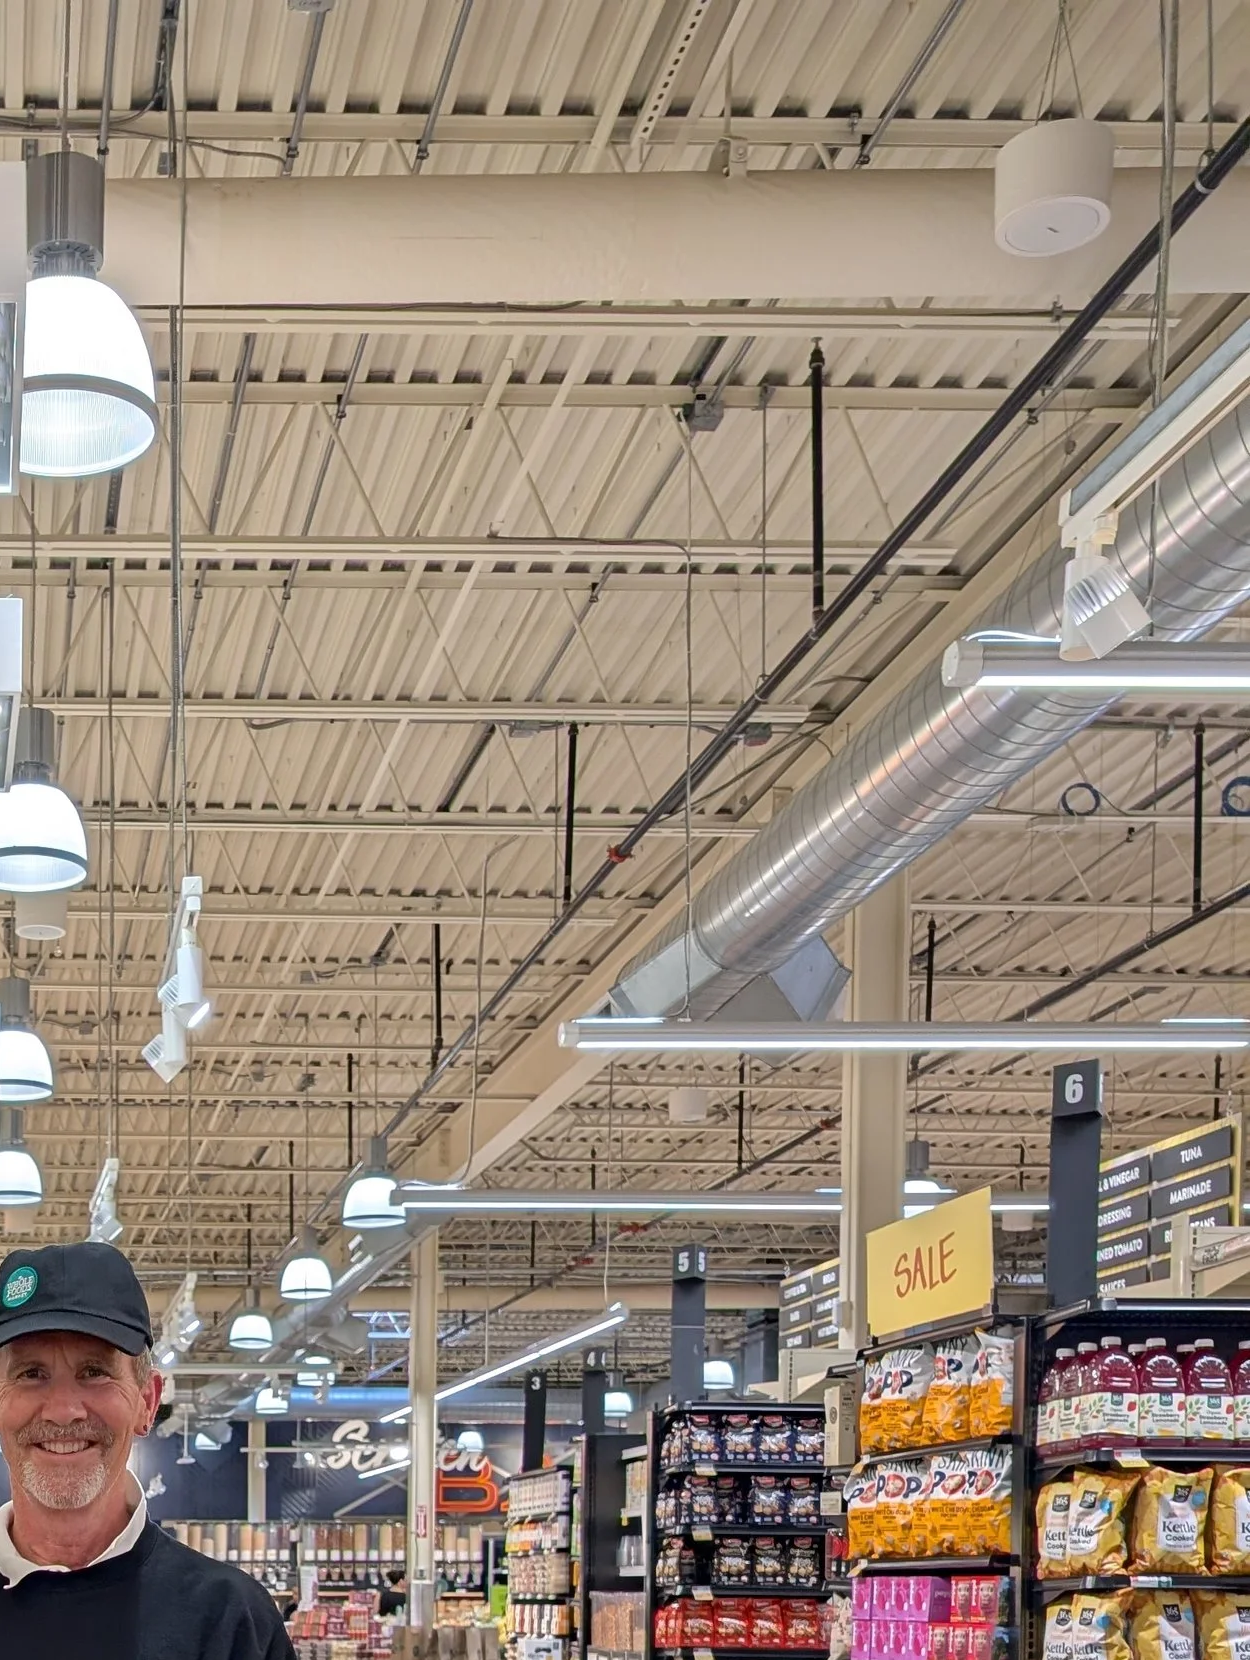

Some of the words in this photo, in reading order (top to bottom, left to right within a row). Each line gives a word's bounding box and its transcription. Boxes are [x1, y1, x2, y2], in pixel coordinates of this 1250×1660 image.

[1064, 1073, 1084, 1104] 6
[1180, 1145, 1202, 1163] TUNA
[1109, 1167, 1140, 1189] VINEGAR
[1170, 1180, 1211, 1204] MARINADE
[1098, 1206, 1132, 1227] DRESSING
[1114, 1238, 1143, 1259] TOMATO
[677, 1252, 689, 1273] 5
[894, 1231, 957, 1298] SALE
[7, 1275, 35, 1290] WHOLE
[531, 1376, 541, 1390] 3
[1162, 1520, 1196, 1533] Kettle
[1166, 1533, 1193, 1542] Cooked
[1074, 1643, 1102, 1655] Kettle
